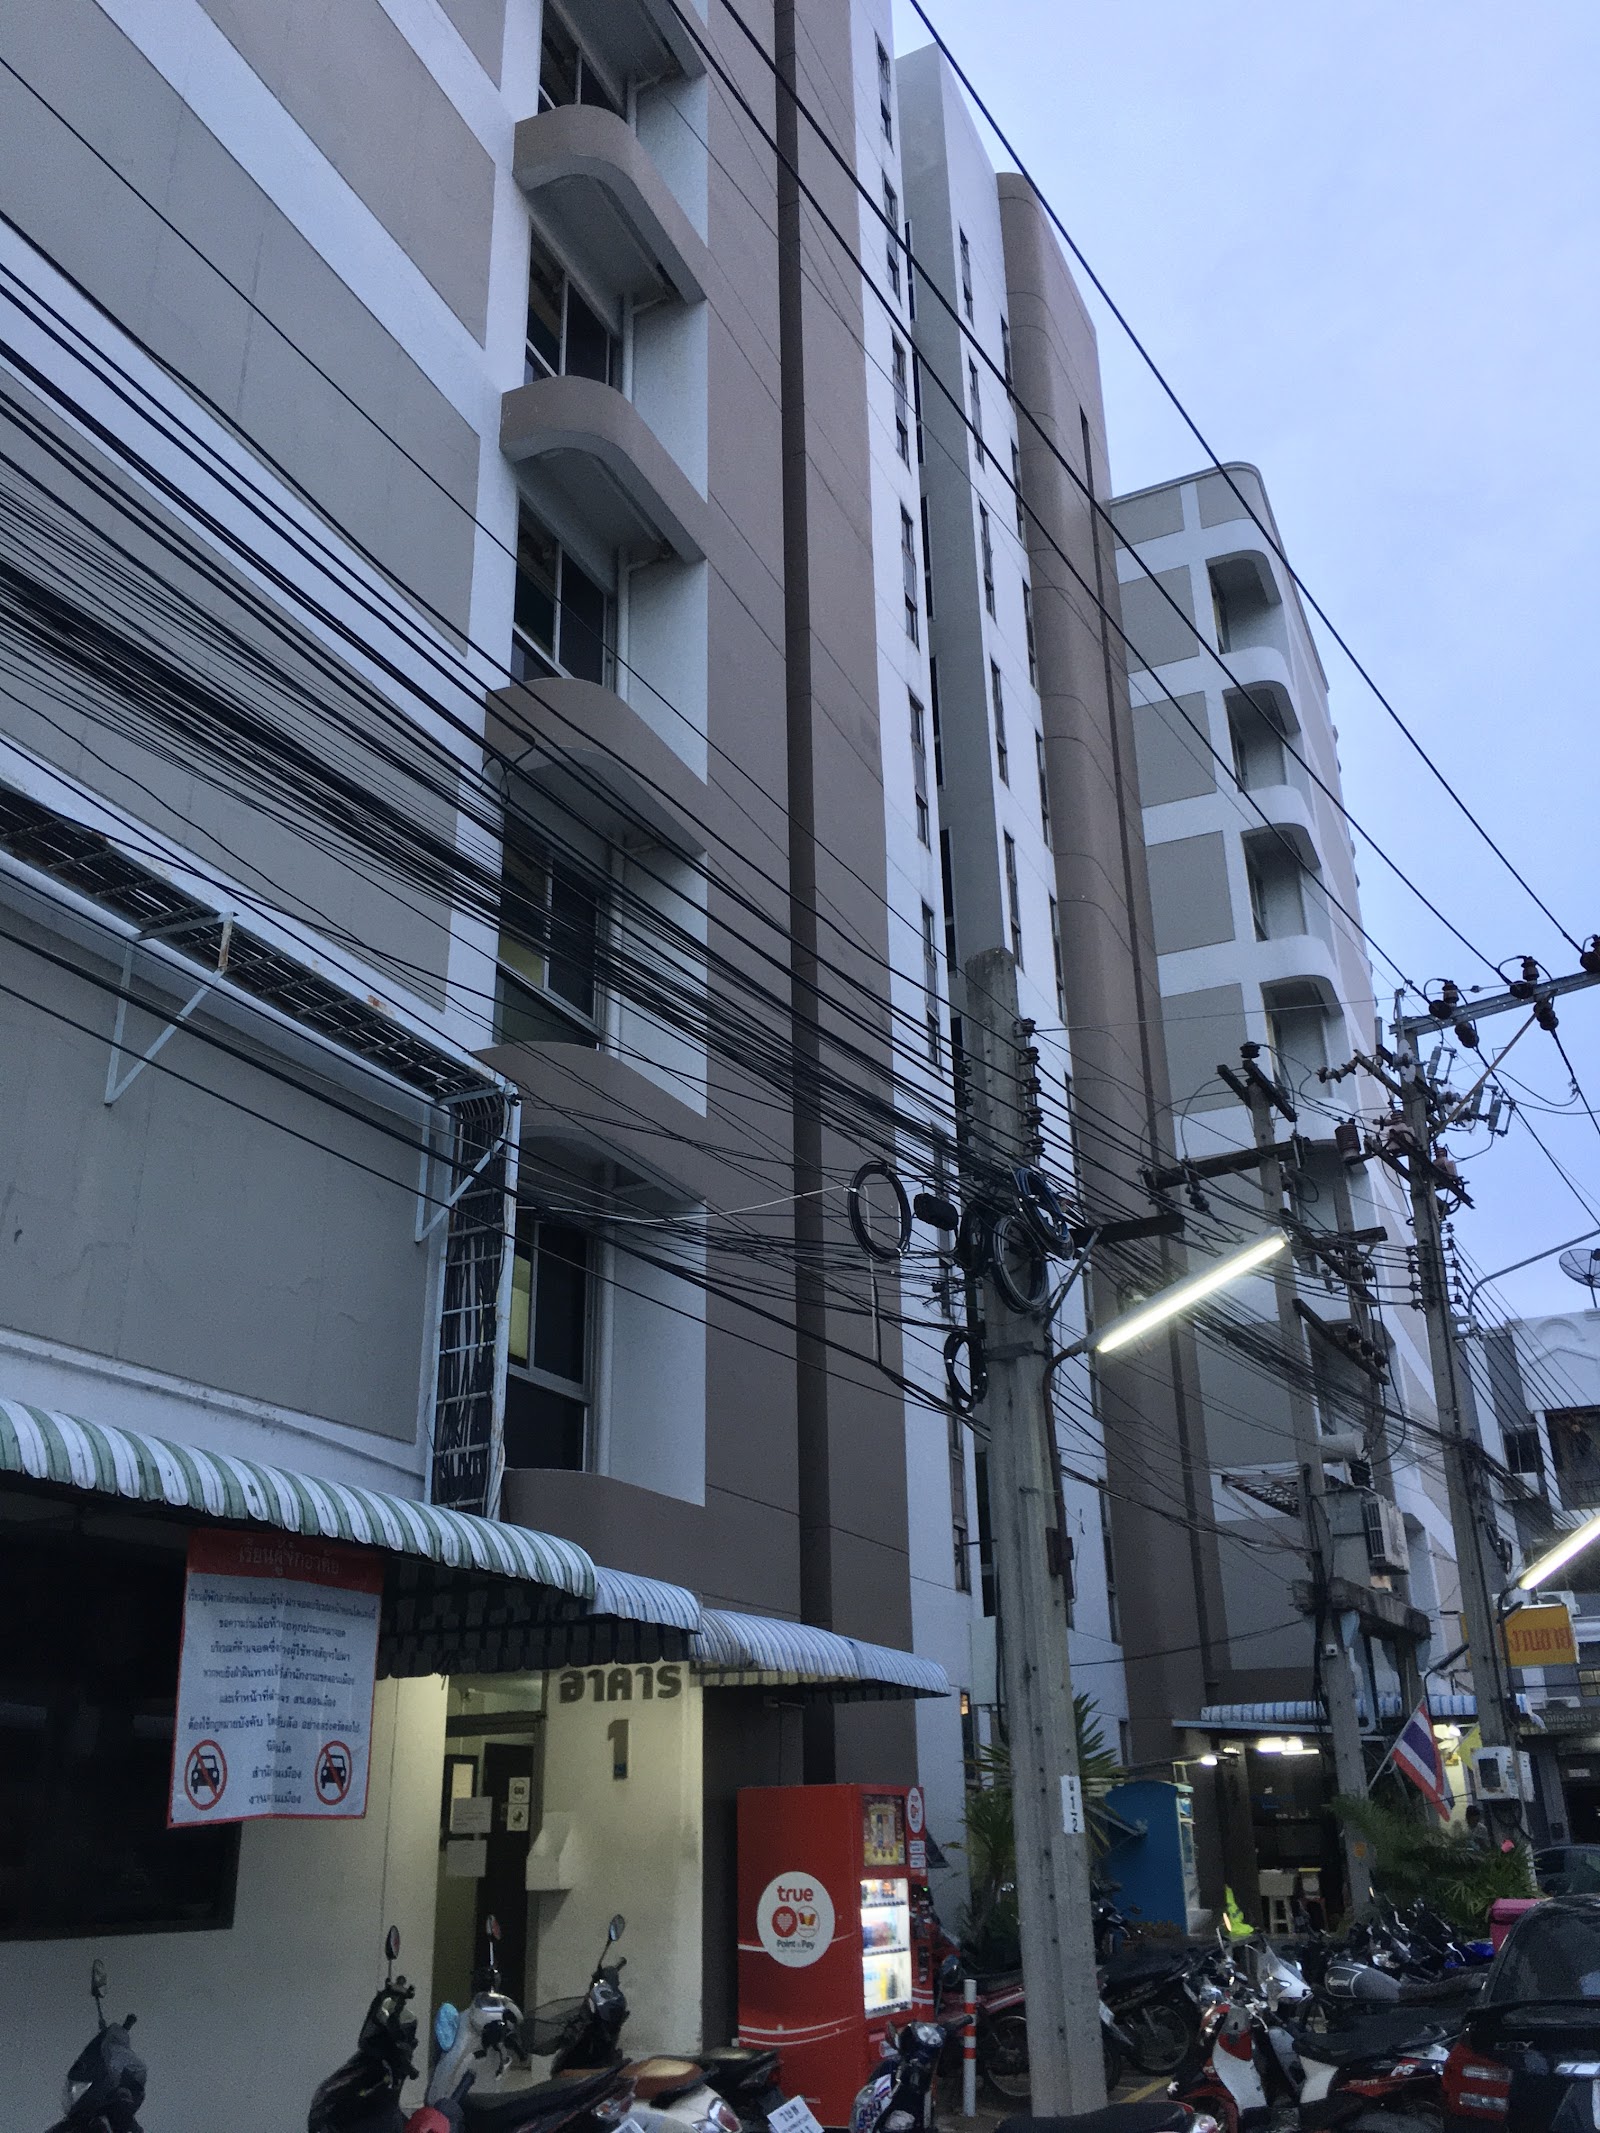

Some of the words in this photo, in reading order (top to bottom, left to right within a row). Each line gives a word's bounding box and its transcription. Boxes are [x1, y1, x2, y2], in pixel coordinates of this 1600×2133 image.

[1510, 1627, 1573, 1653] งานขาย
[559, 1665, 682, 1704] อาคาร
[607, 1719, 629, 1780] 1
[776, 1885, 814, 1902] true
[776, 1939, 796, 1948] Point
[801, 1939, 816, 1950] Pay
